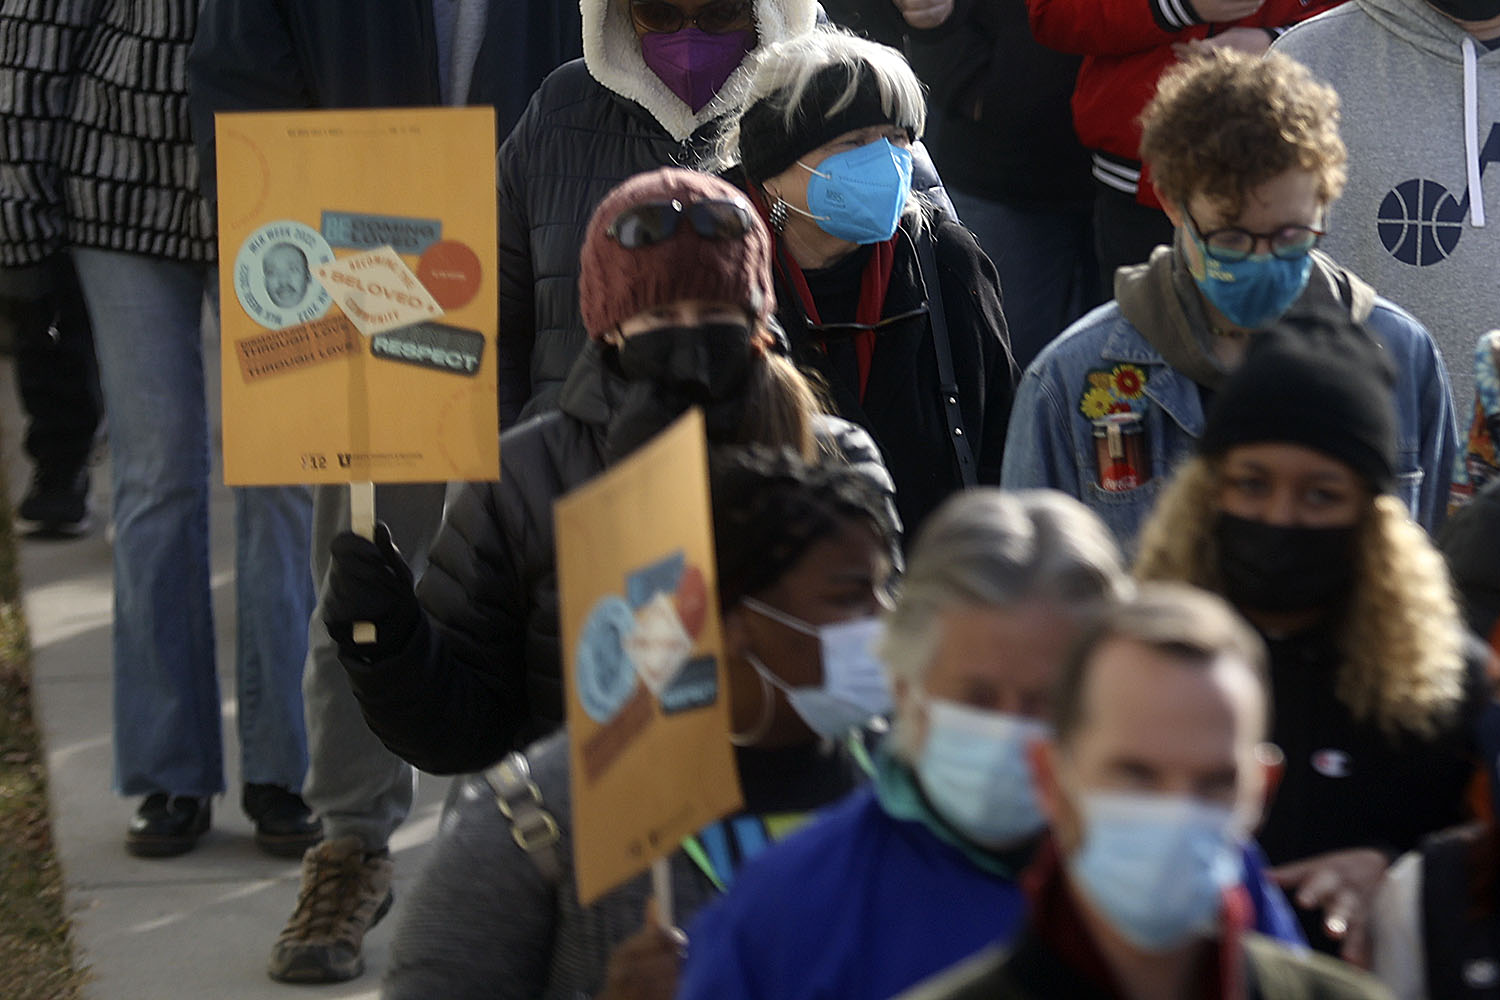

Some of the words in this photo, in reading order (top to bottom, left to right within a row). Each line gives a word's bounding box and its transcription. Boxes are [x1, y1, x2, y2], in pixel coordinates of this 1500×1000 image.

[265, 227, 291, 240] WEEK
[331, 271, 422, 309] BELOVED
[244, 333, 310, 357] THROUGH
[313, 322, 349, 338] LOVE
[372, 336, 479, 372] RESPECT
[248, 352, 315, 377] THROUGH
[318, 341, 353, 358] LOVE
